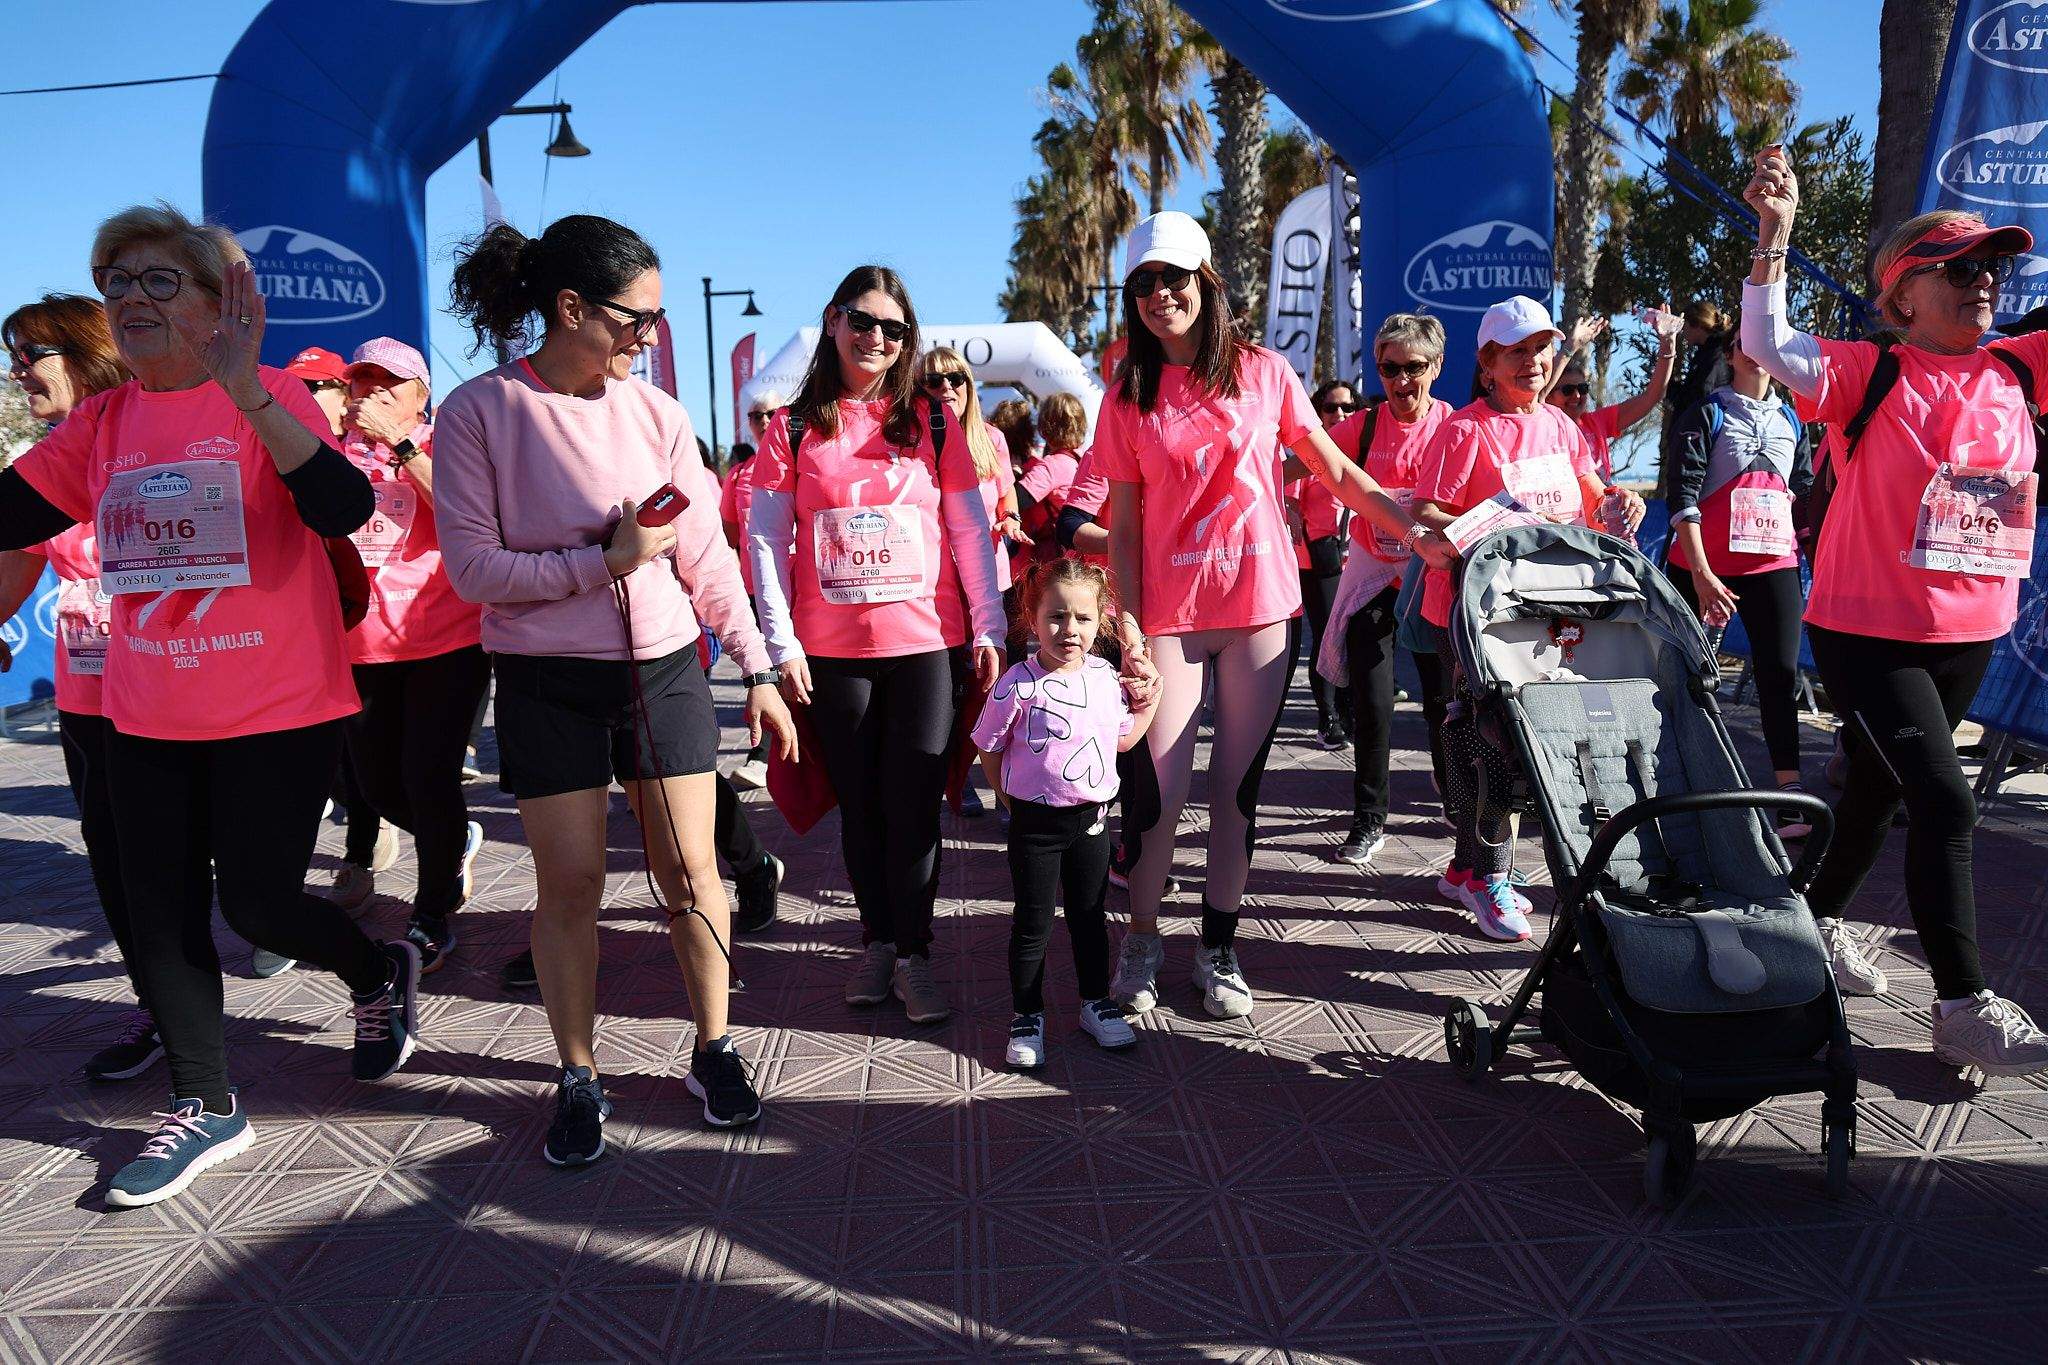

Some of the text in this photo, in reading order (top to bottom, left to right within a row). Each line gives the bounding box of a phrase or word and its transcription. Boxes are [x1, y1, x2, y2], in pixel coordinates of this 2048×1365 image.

[1275, 229, 1322, 382] SHO
[142, 481, 189, 494] ASTURIANA
[1964, 480, 2005, 493] ASTURIANA
[1536, 491, 1562, 506] 016
[145, 519, 196, 541] 016
[354, 519, 384, 534] 16
[1755, 517, 1779, 529] 016
[1960, 514, 2000, 533] 016
[157, 546, 181, 556] 2605
[852, 549, 892, 566] 016
[1171, 549, 1212, 567] CARRERA
[1231, 545, 1243, 558] LA
[117, 560, 147, 569] CARRERA
[149, 560, 158, 568] DE
[166, 557, 188, 566] MUJER
[194, 556, 227, 565] VALENCIA
[1926, 554, 2018, 571] OYSHO Santander
[117, 572, 231, 587] OYSHO Santander
[831, 590, 863, 599] OYSHO
[167, 638, 188, 655] DE
[191, 637, 209, 653] LA
[211, 630, 264, 651] MUJER
[173, 656, 200, 669] 2025
